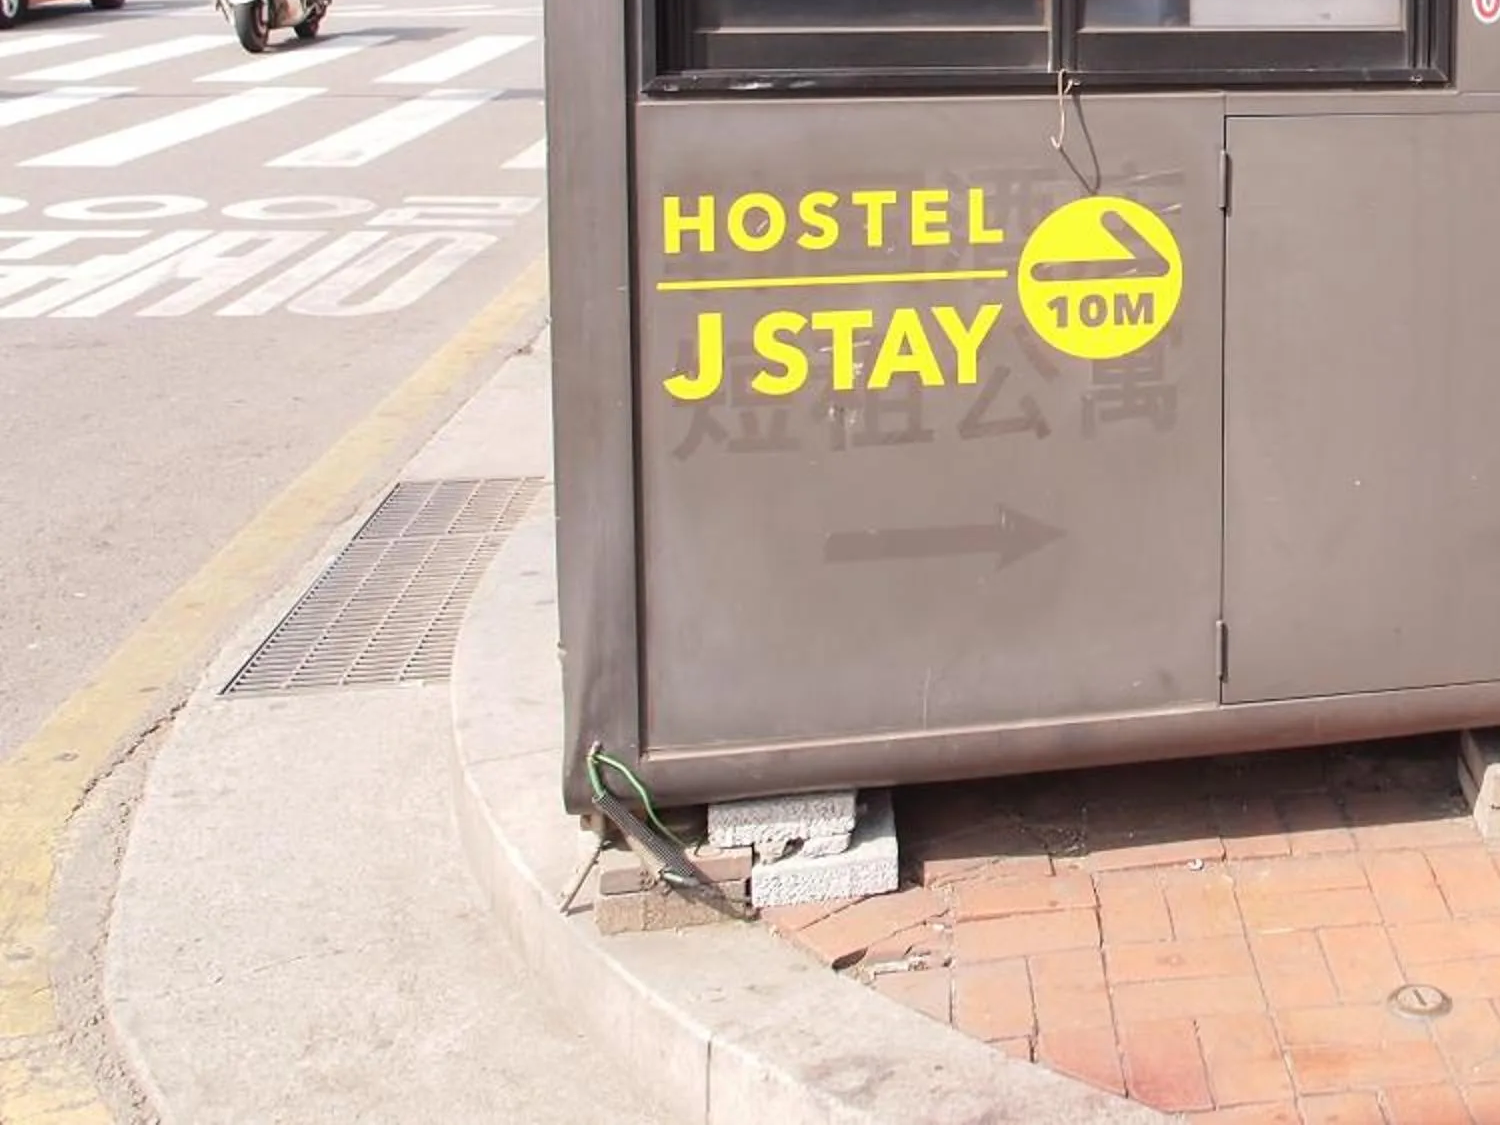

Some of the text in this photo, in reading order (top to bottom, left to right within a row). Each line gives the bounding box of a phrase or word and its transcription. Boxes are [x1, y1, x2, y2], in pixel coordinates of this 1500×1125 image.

[663, 187, 1005, 254] HOSTEL
[1046, 292, 1155, 330] 10M
[664, 304, 1004, 400] J STAY
